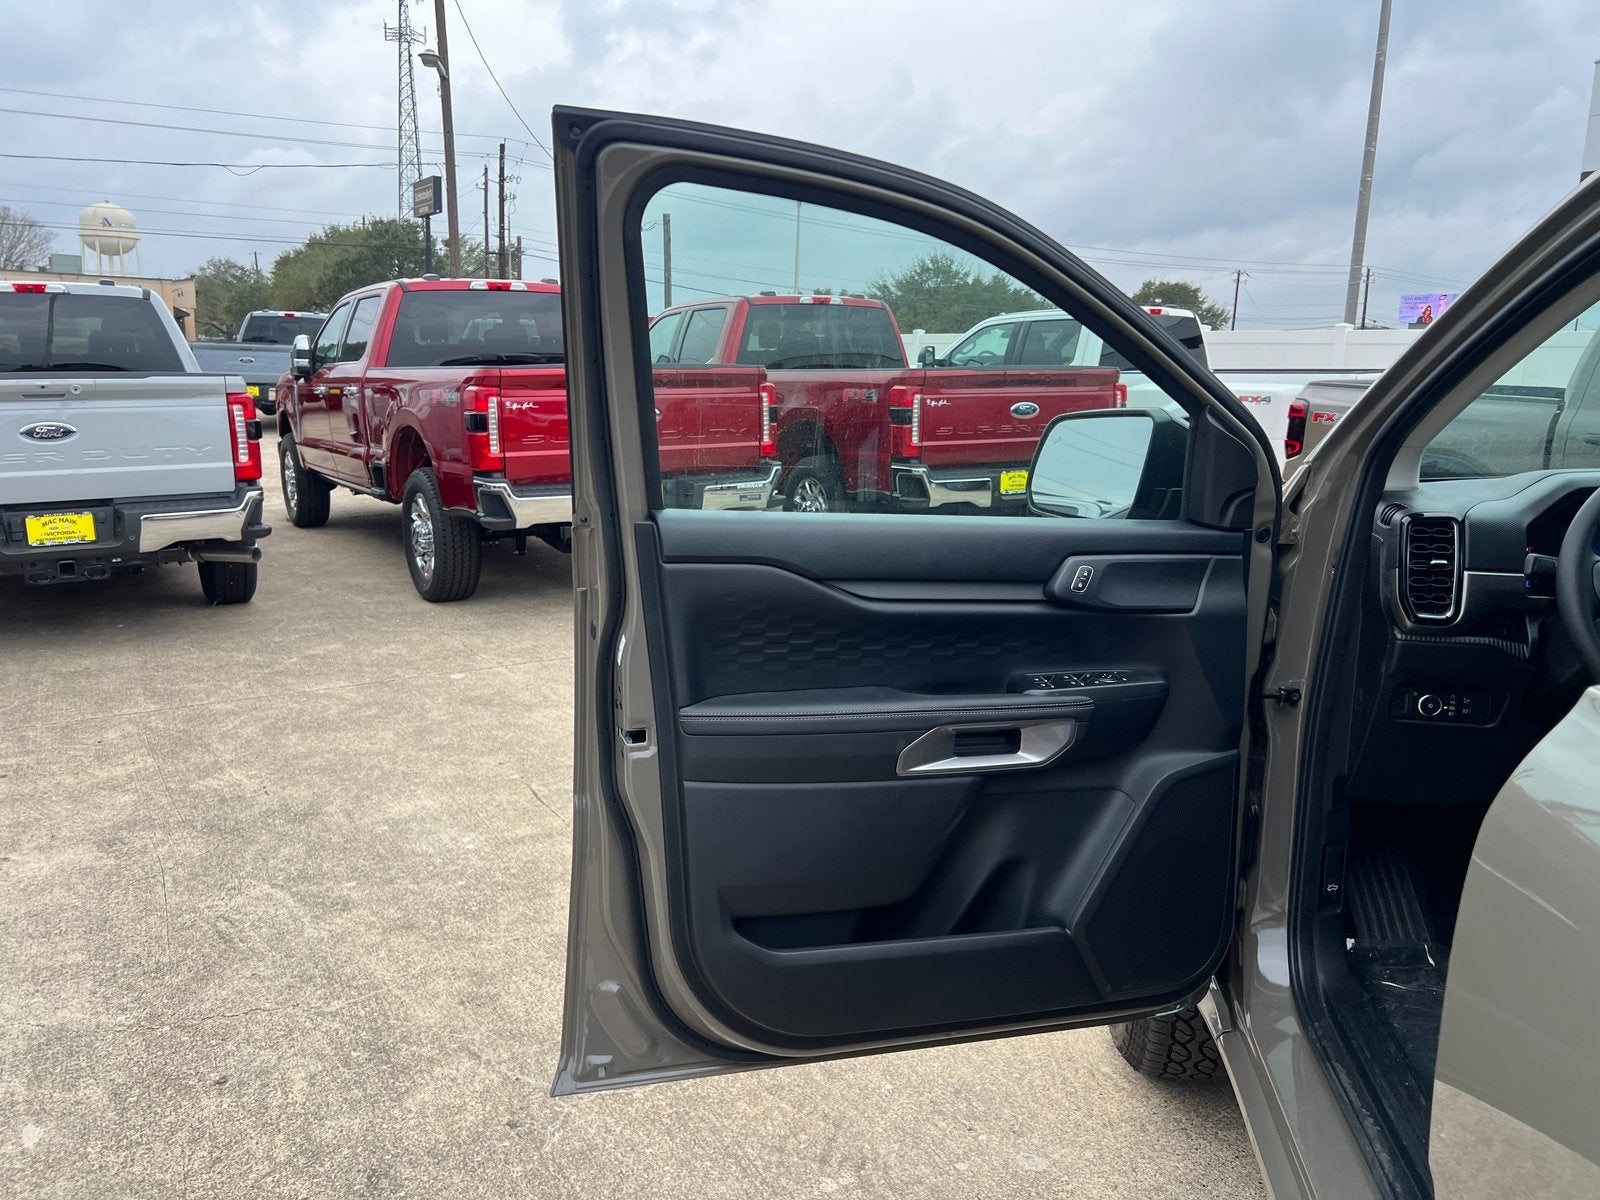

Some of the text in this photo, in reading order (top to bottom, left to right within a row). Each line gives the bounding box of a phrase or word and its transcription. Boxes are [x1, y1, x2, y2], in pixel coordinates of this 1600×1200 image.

[842, 388, 878, 404] FX4
[1238, 395, 1271, 404] FX4
[33, 426, 64, 438] Ford
[661, 427, 747, 439] DUTY
[936, 424, 1031, 435] SUPER
[81, 446, 212, 461] DUTY
[42, 517, 77, 527] MAC HAIK
